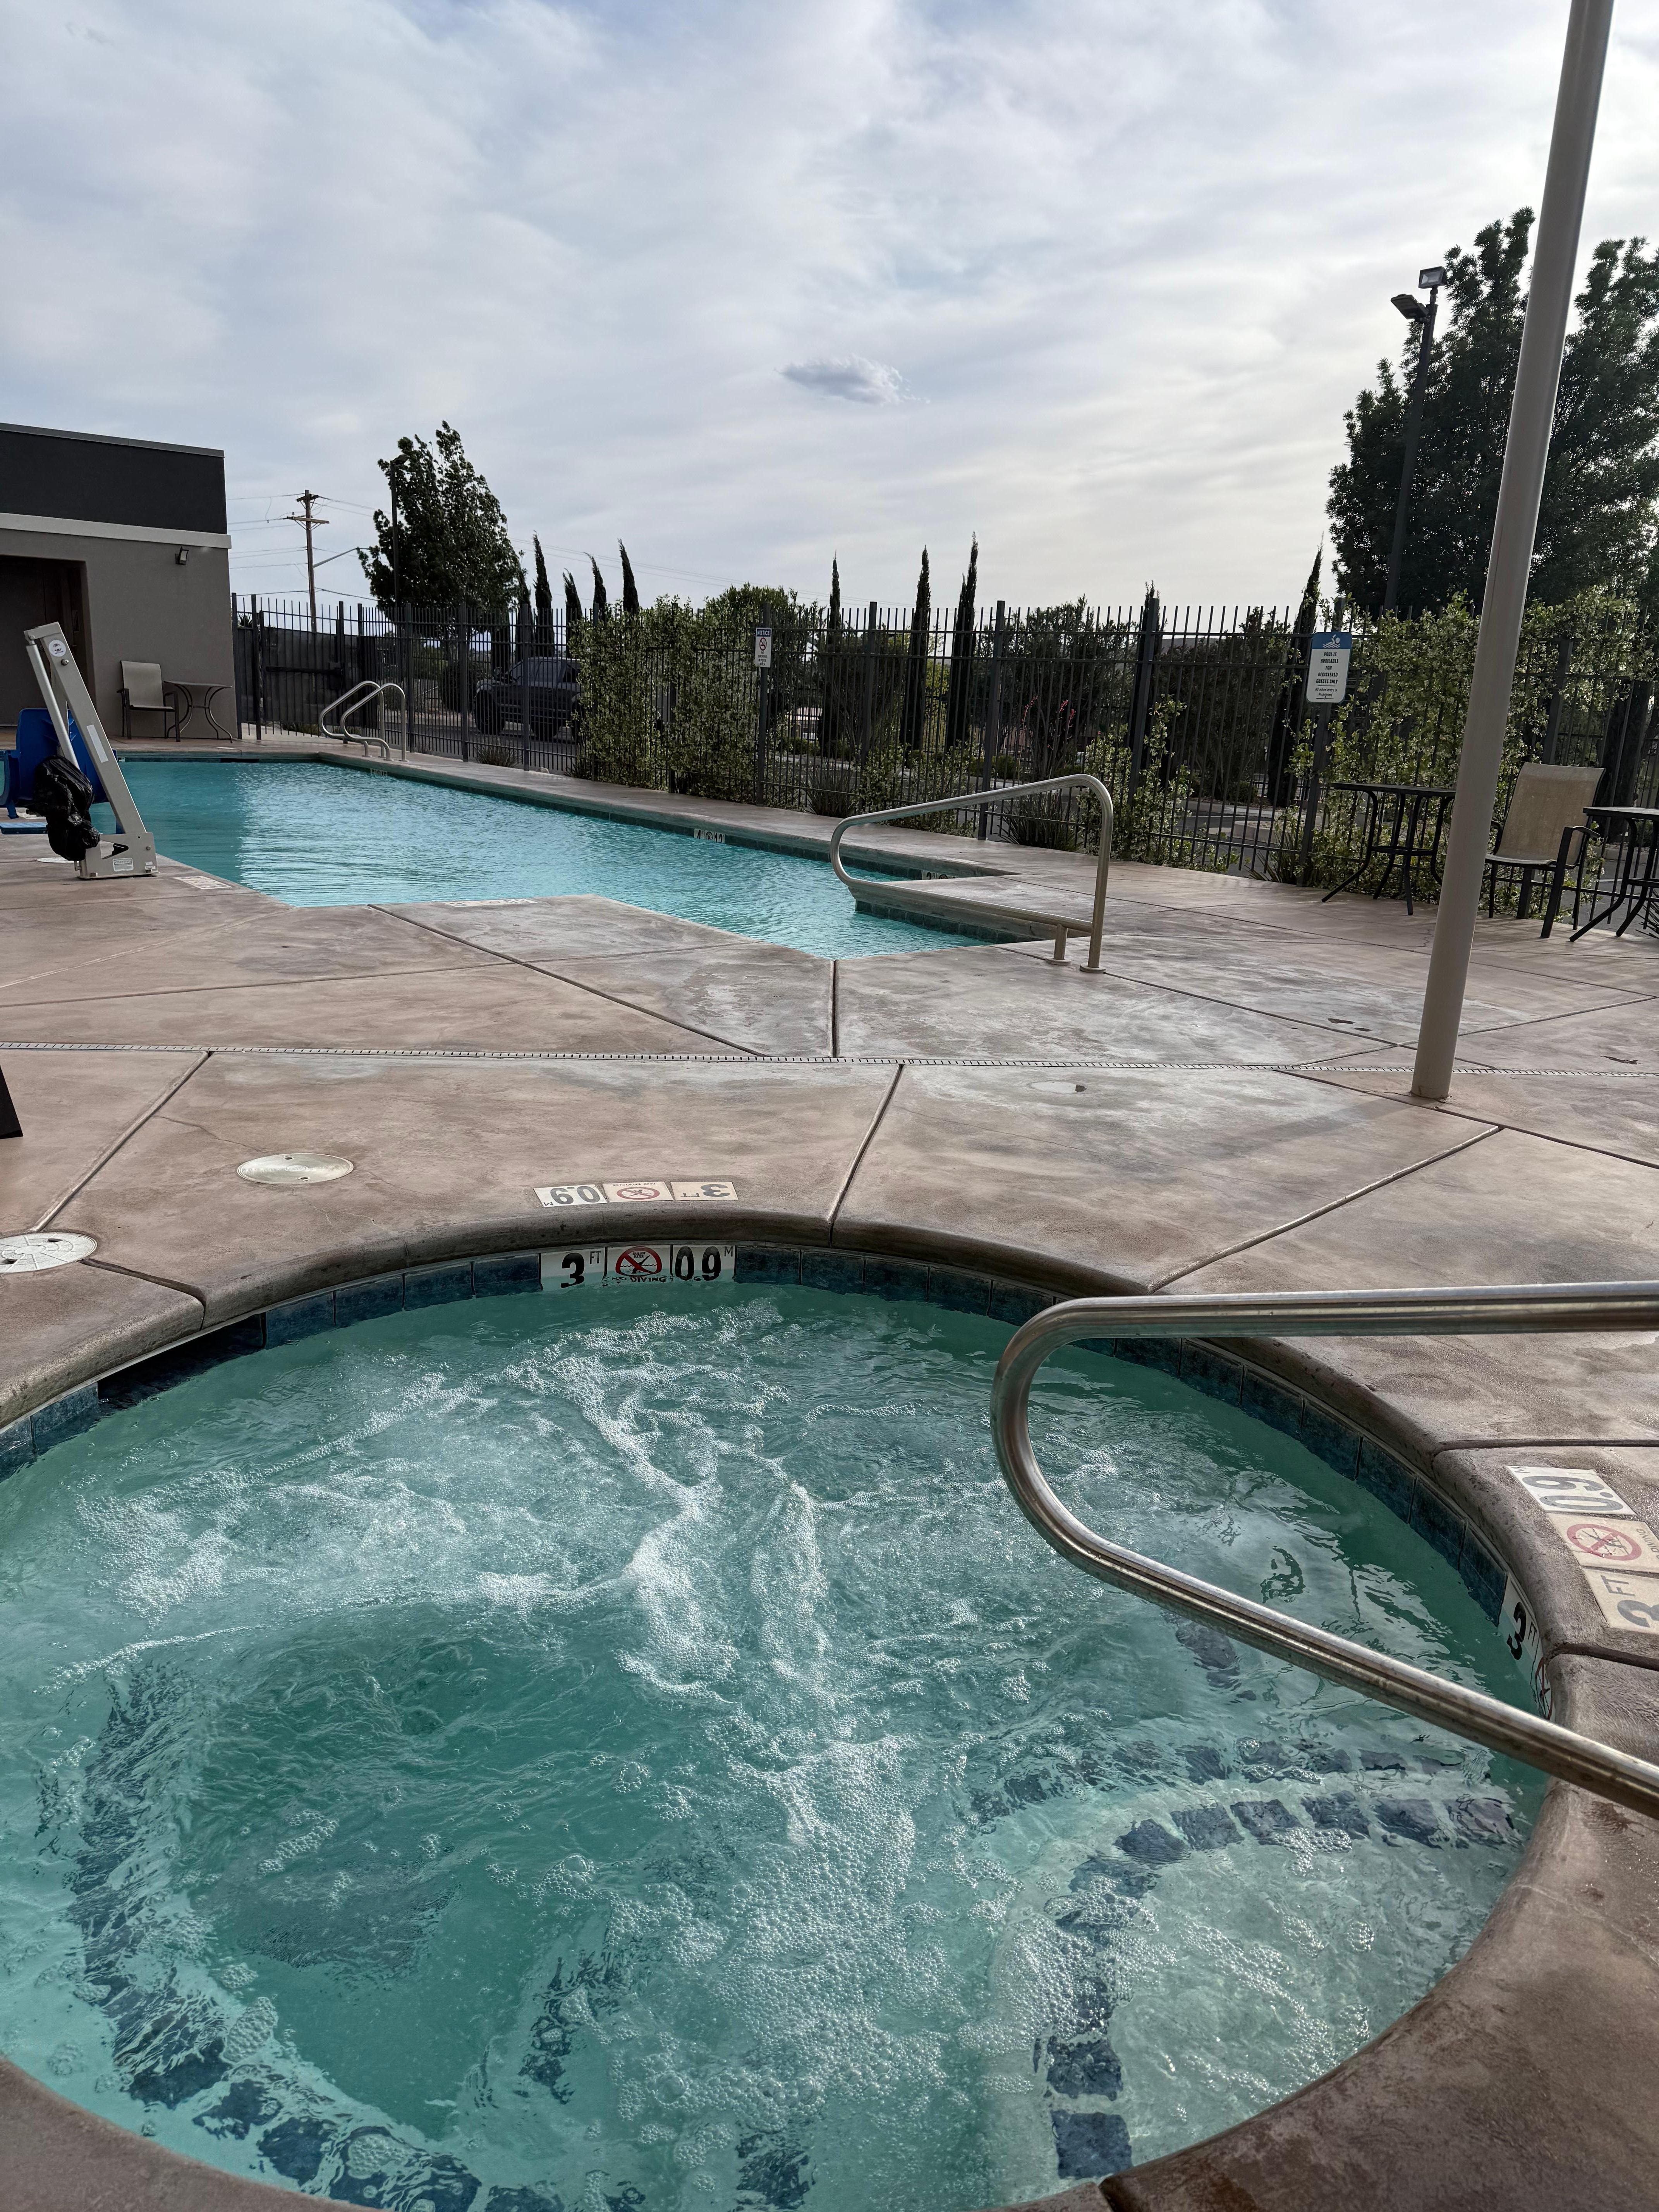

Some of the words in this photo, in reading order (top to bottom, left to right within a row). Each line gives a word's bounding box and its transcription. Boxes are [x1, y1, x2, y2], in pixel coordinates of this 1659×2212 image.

[701, 1184, 730, 1197] 3
[724, 1246, 733, 1257] M
[561, 1252, 585, 1288] 3
[590, 1250, 601, 1264] FT
[1601, 1575, 1635, 1596] FT
[1506, 1602, 1526, 1660] 3
[1528, 1621, 1537, 1647] FT
